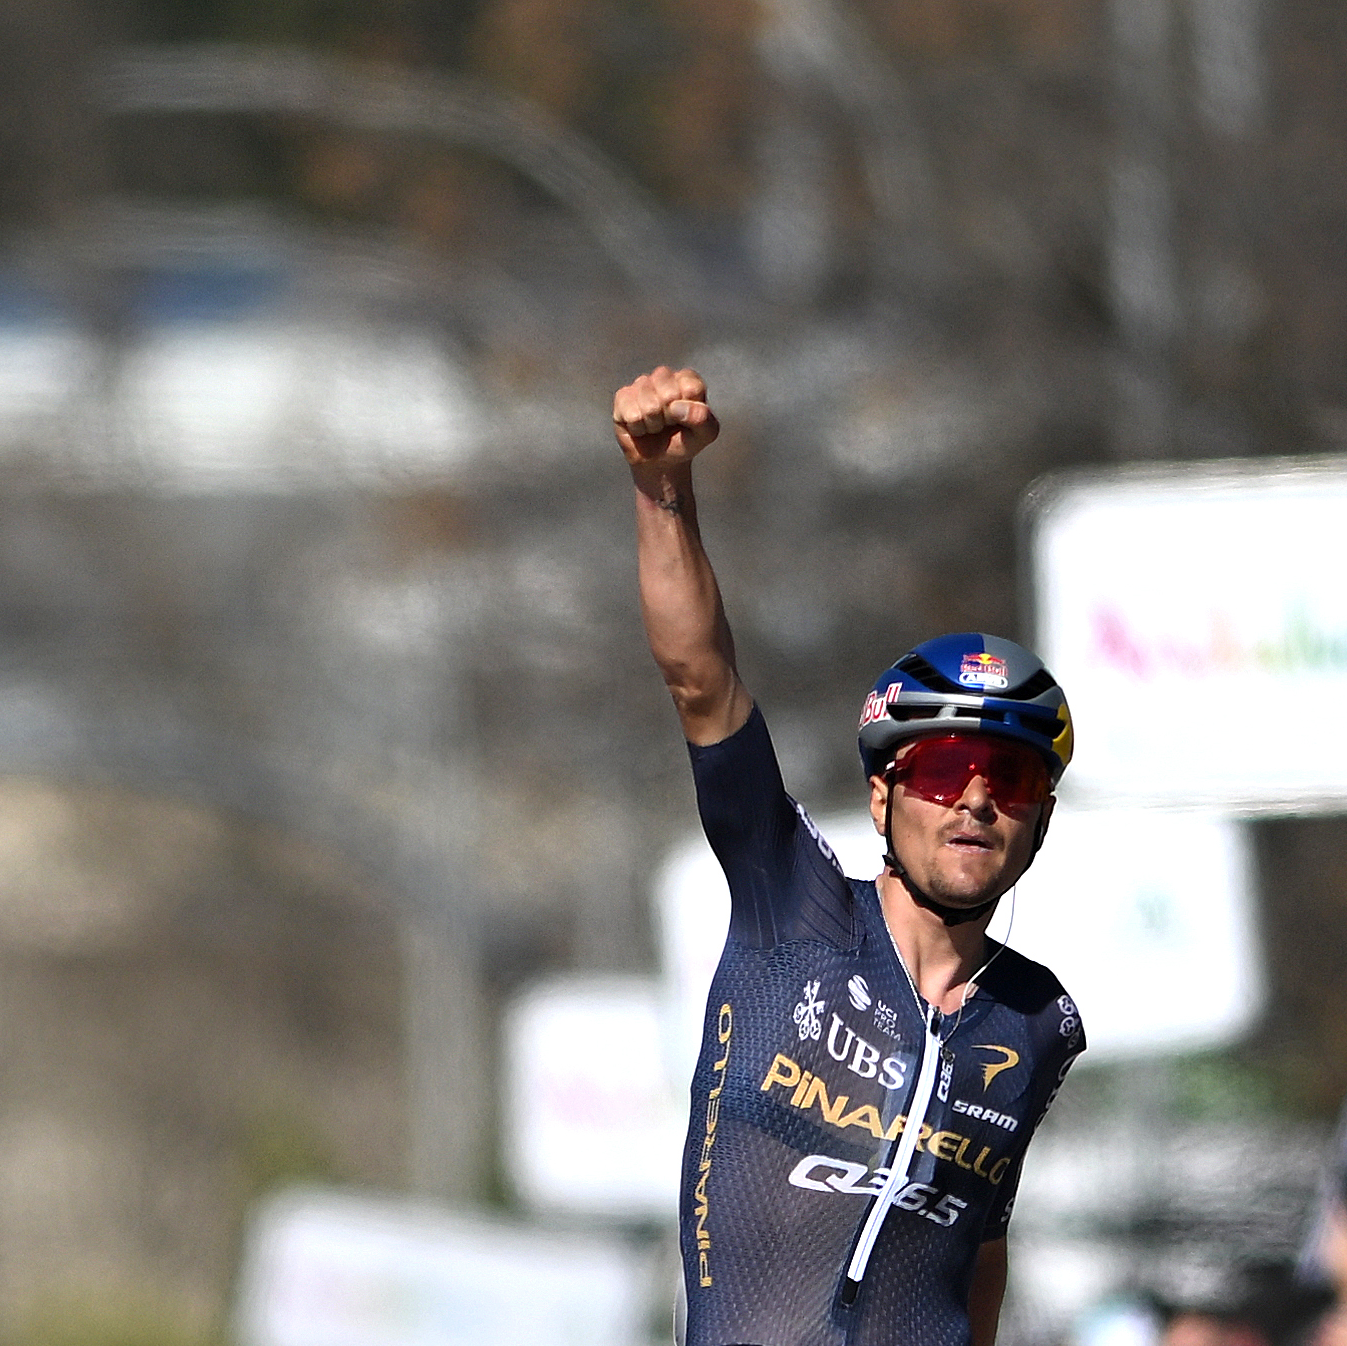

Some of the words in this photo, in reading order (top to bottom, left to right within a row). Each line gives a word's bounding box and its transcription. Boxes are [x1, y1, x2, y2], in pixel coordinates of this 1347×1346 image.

[874, 1010, 896, 1029] PRO
[877, 1000, 898, 1021] UCI
[872, 1018, 902, 1041] TEAM
[827, 1012, 907, 1090] UBS
[760, 1053, 1011, 1185] PINARELLO
[952, 1100, 1019, 1132] SRAM
[696, 1003, 733, 1288] PINARELLO
